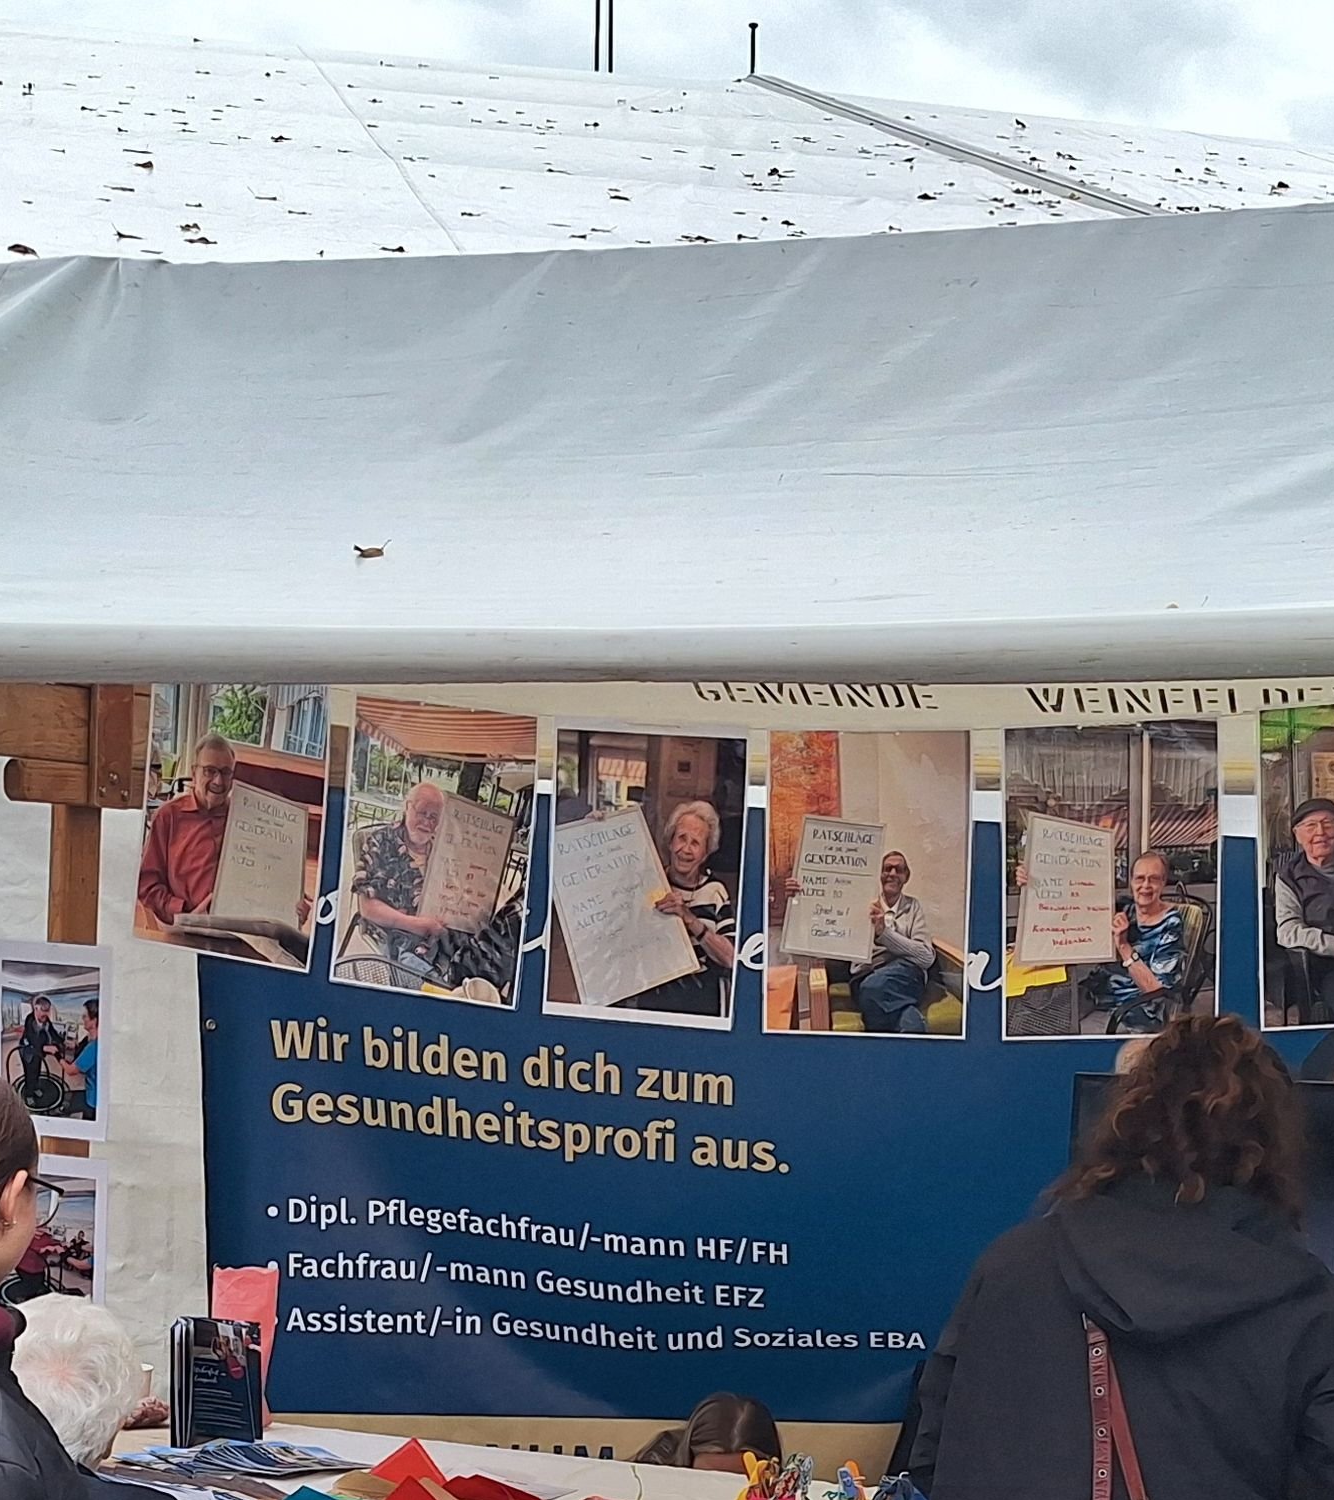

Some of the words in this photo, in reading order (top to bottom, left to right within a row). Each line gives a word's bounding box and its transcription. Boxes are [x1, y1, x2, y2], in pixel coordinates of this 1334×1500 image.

[270, 1017, 349, 1062] Wir
[363, 1026, 507, 1082] bilden
[523, 1045, 621, 1095] dich
[636, 1066, 735, 1106] zum
[271, 1082, 677, 1163] Gesundheitsprofi
[691, 1134, 791, 1174] aus.
[286, 1197, 359, 1231] Dipl.
[368, 1200, 686, 1258] Pflegefachfrau/-mann
[696, 1236, 789, 1266] HF/FH
[286, 1252, 527, 1290] Fachfrau/-mann
[536, 1269, 705, 1307] Gesundheit
[714, 1285, 766, 1309] EFZ
[286, 1305, 483, 1339] Assistent/-in
[492, 1313, 658, 1351] Gesundheit
[667, 1325, 724, 1351] und
[733, 1325, 860, 1350] Soziales
[869, 1330, 927, 1351] EBA
